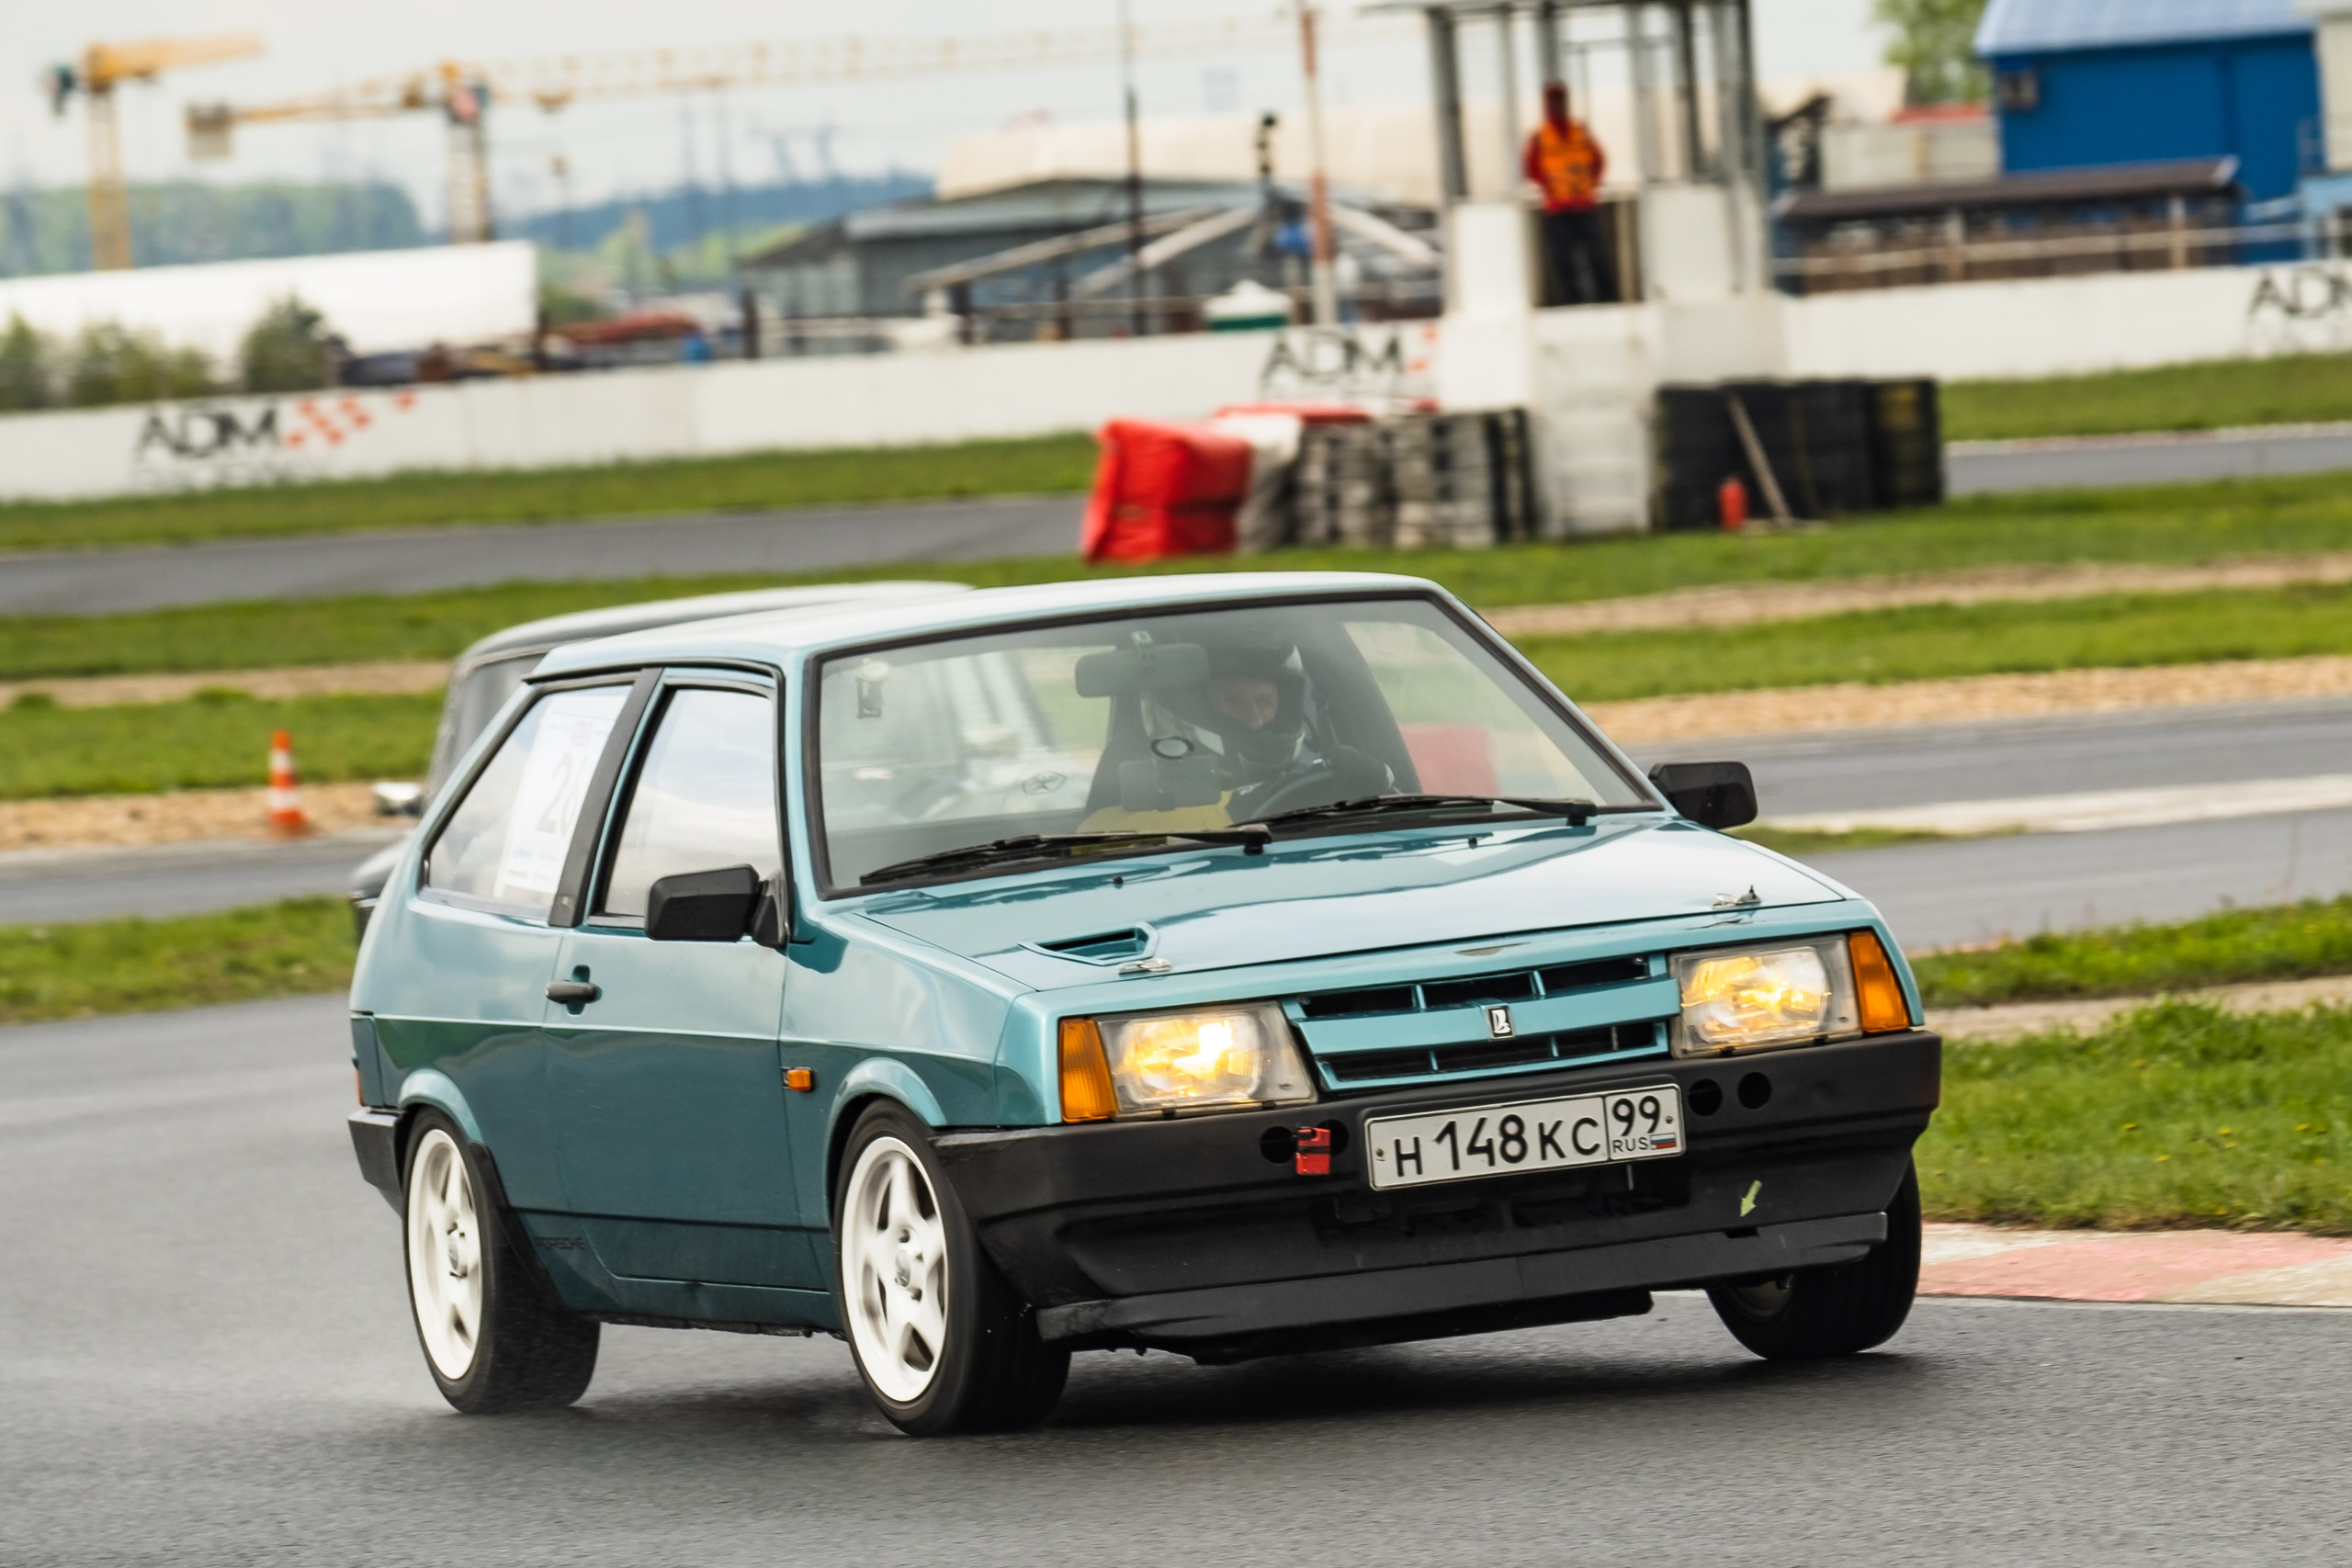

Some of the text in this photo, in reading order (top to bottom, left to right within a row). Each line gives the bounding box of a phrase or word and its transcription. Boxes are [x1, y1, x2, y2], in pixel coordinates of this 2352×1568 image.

[1260, 326, 1405, 387] ADM
[135, 405, 278, 460] ADM
[1611, 1095, 1661, 1136] 99
[1612, 1136, 1649, 1154] RUS
